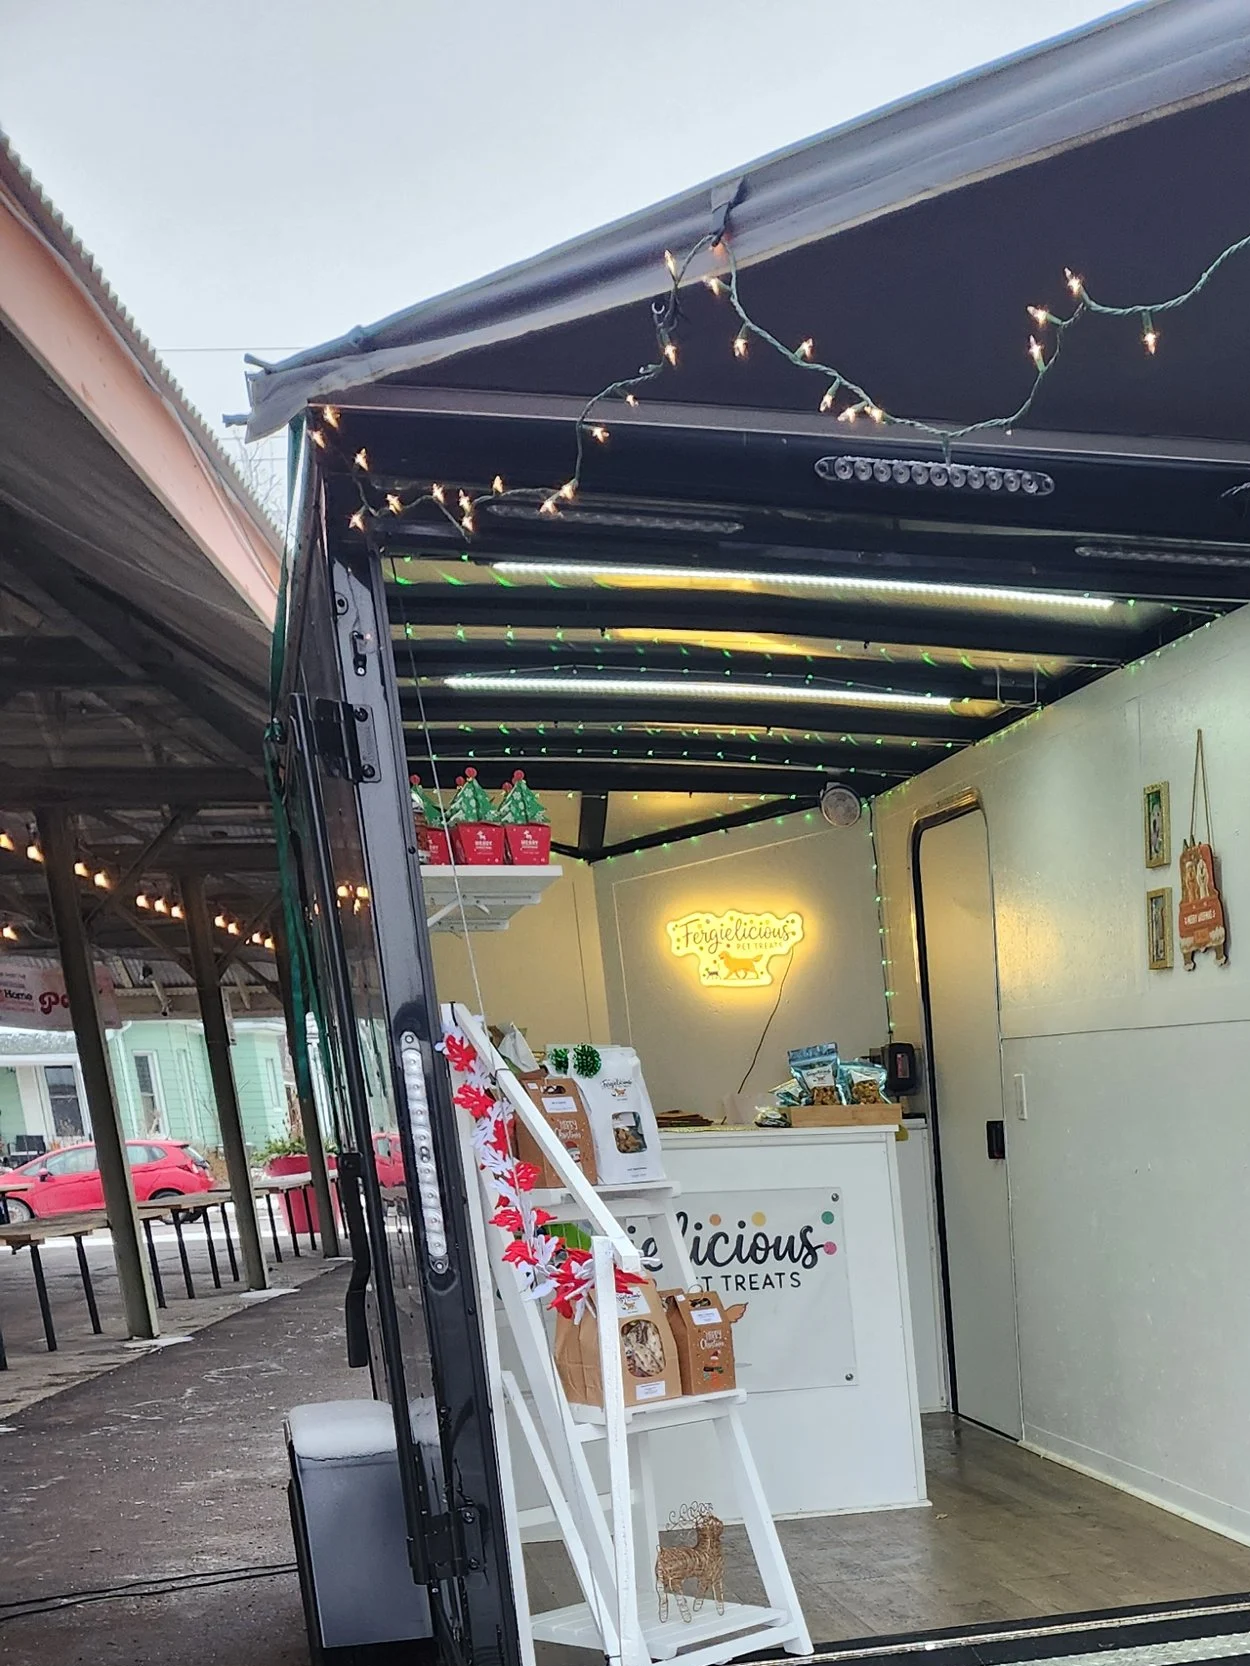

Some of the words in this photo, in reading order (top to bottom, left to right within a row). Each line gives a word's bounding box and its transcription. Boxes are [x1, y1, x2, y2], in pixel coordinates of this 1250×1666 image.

[679, 917, 793, 955] Fergielicious
[736, 942, 751, 950] PET
[721, 1272, 801, 1292] TREATS
